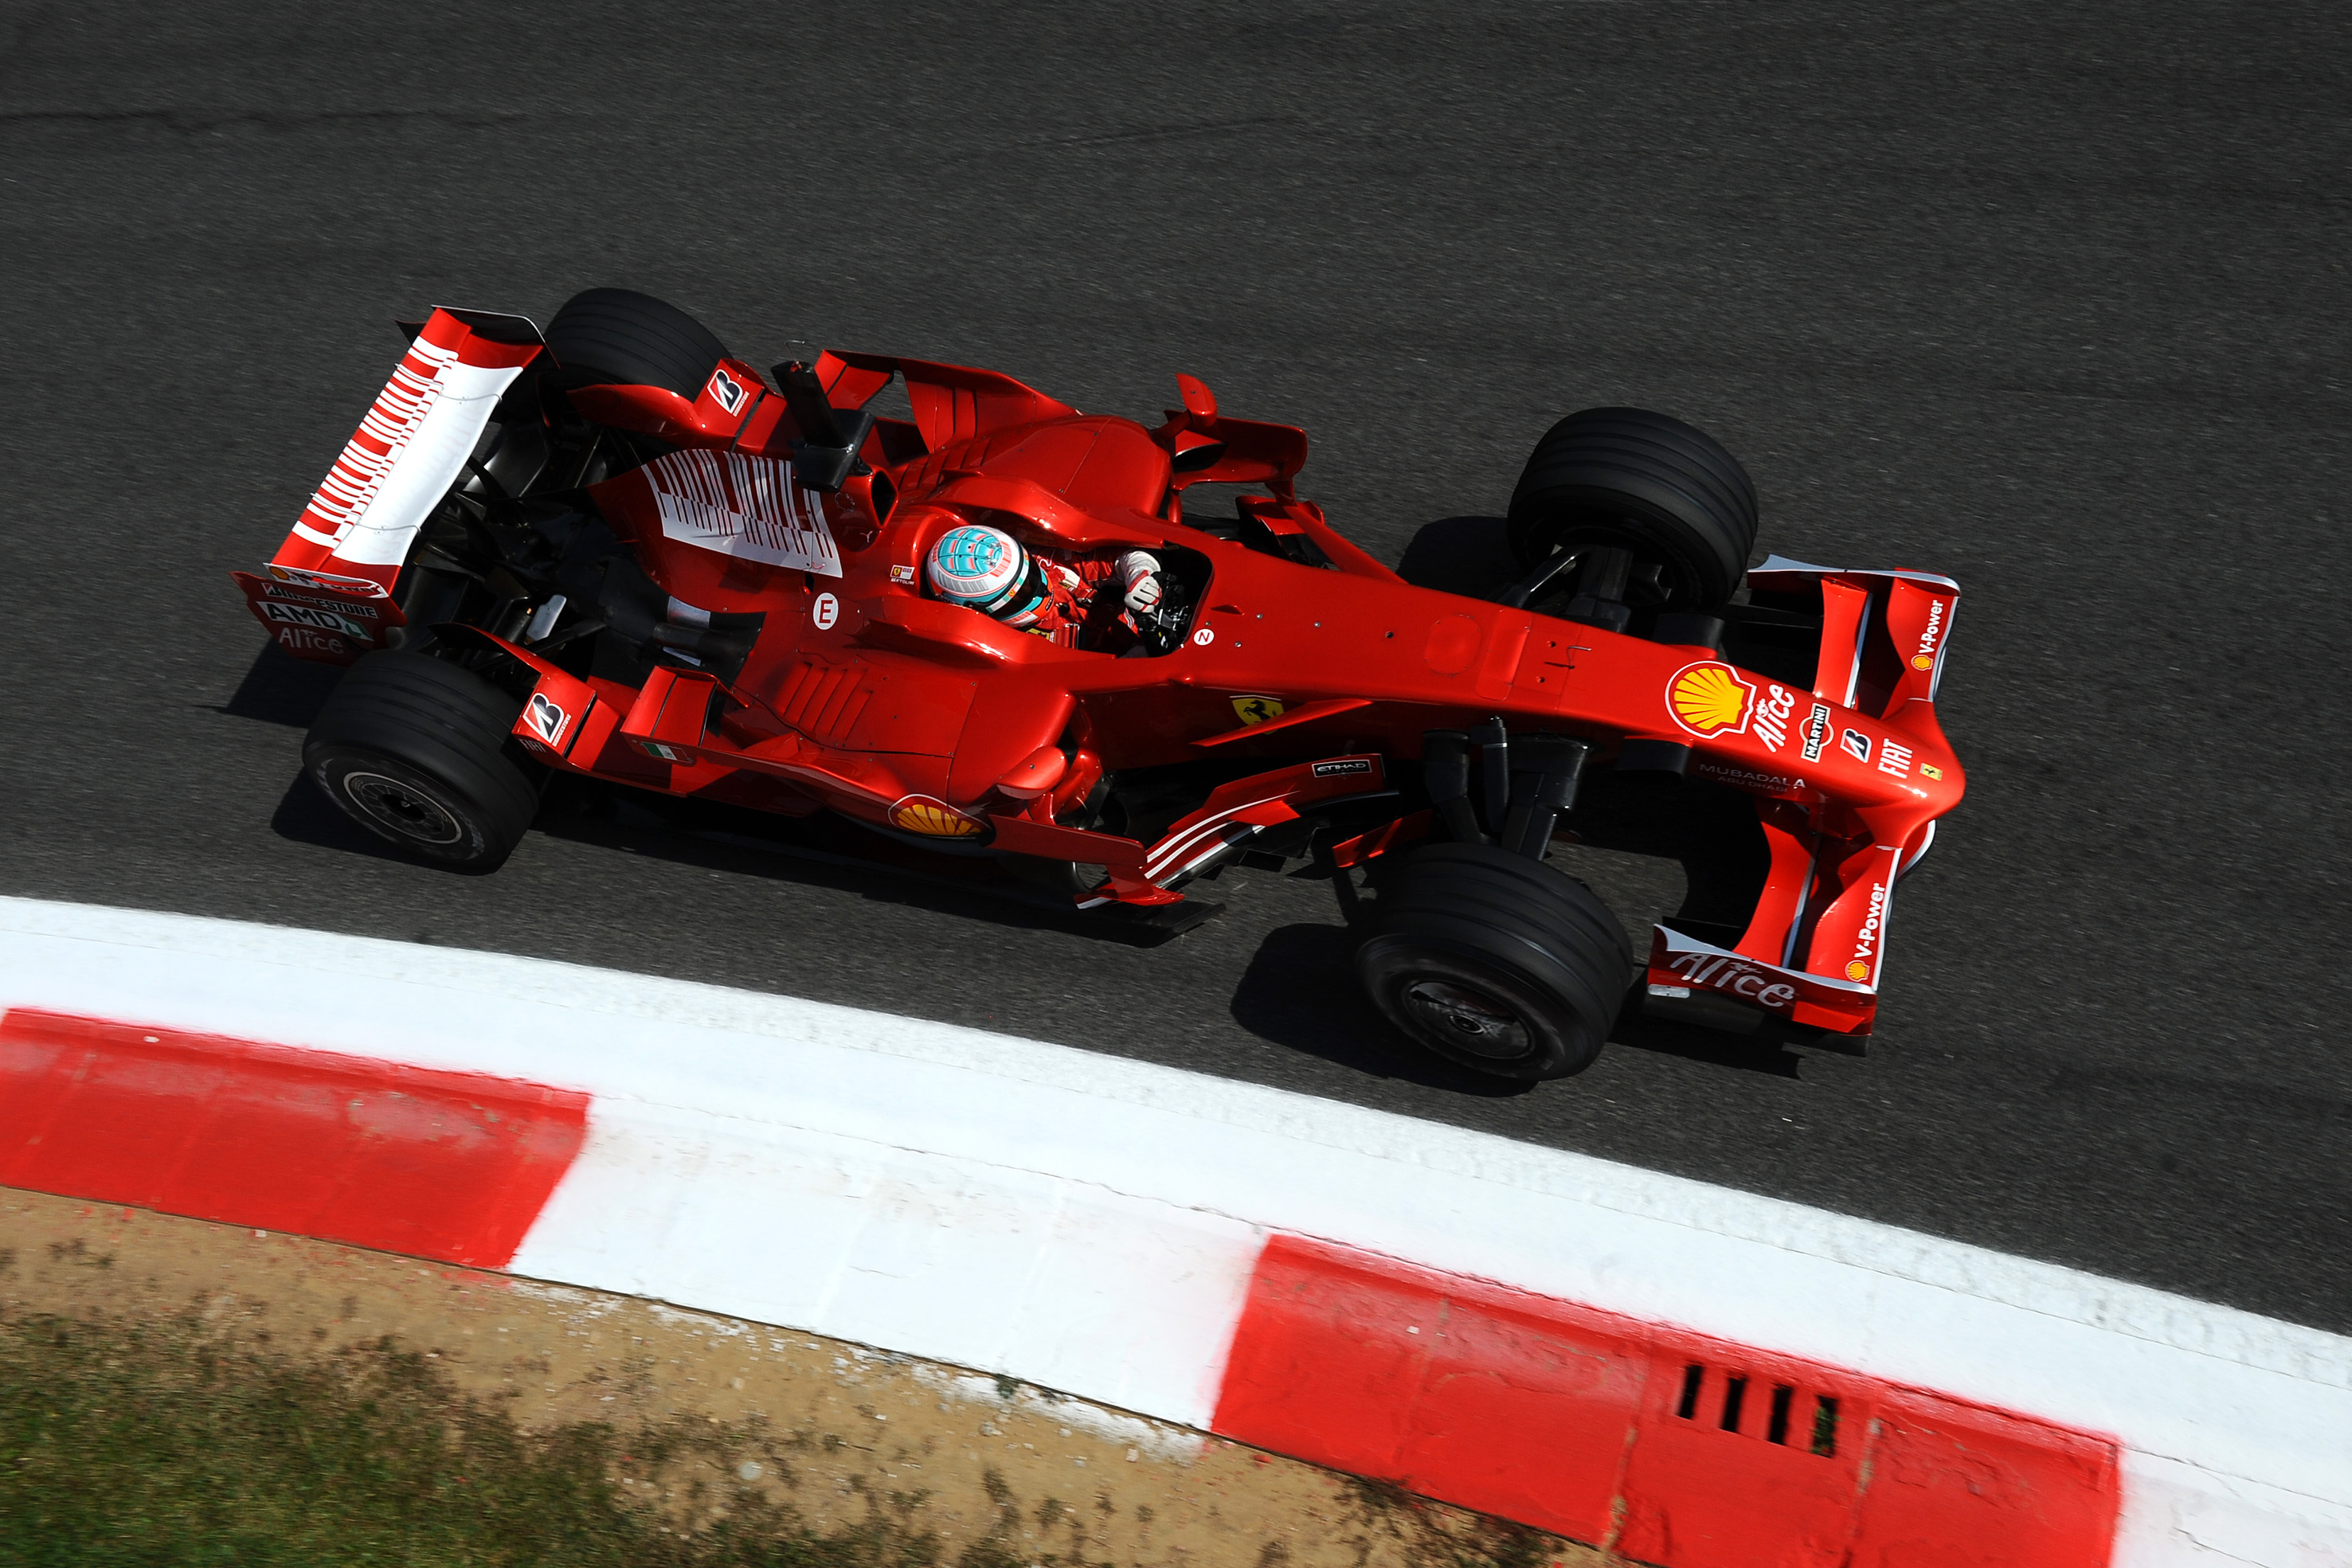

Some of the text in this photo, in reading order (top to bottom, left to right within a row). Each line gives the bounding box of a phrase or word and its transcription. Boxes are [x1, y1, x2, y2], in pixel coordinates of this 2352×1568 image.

[266, 603, 342, 631] AMD
[819, 600, 833, 624] E
[1919, 600, 1943, 653] V-Power
[280, 628, 344, 655] Alice
[1198, 632, 1210, 643] N
[1752, 684, 1795, 753] Alice
[1806, 708, 1826, 757] MARTINI
[519, 738, 547, 753] FIAT
[1877, 738, 1913, 779] FIAT
[1700, 764, 1806, 788] MUBADALA
[1854, 882, 1885, 959] V-Power
[1669, 953, 1796, 1007] Alice
